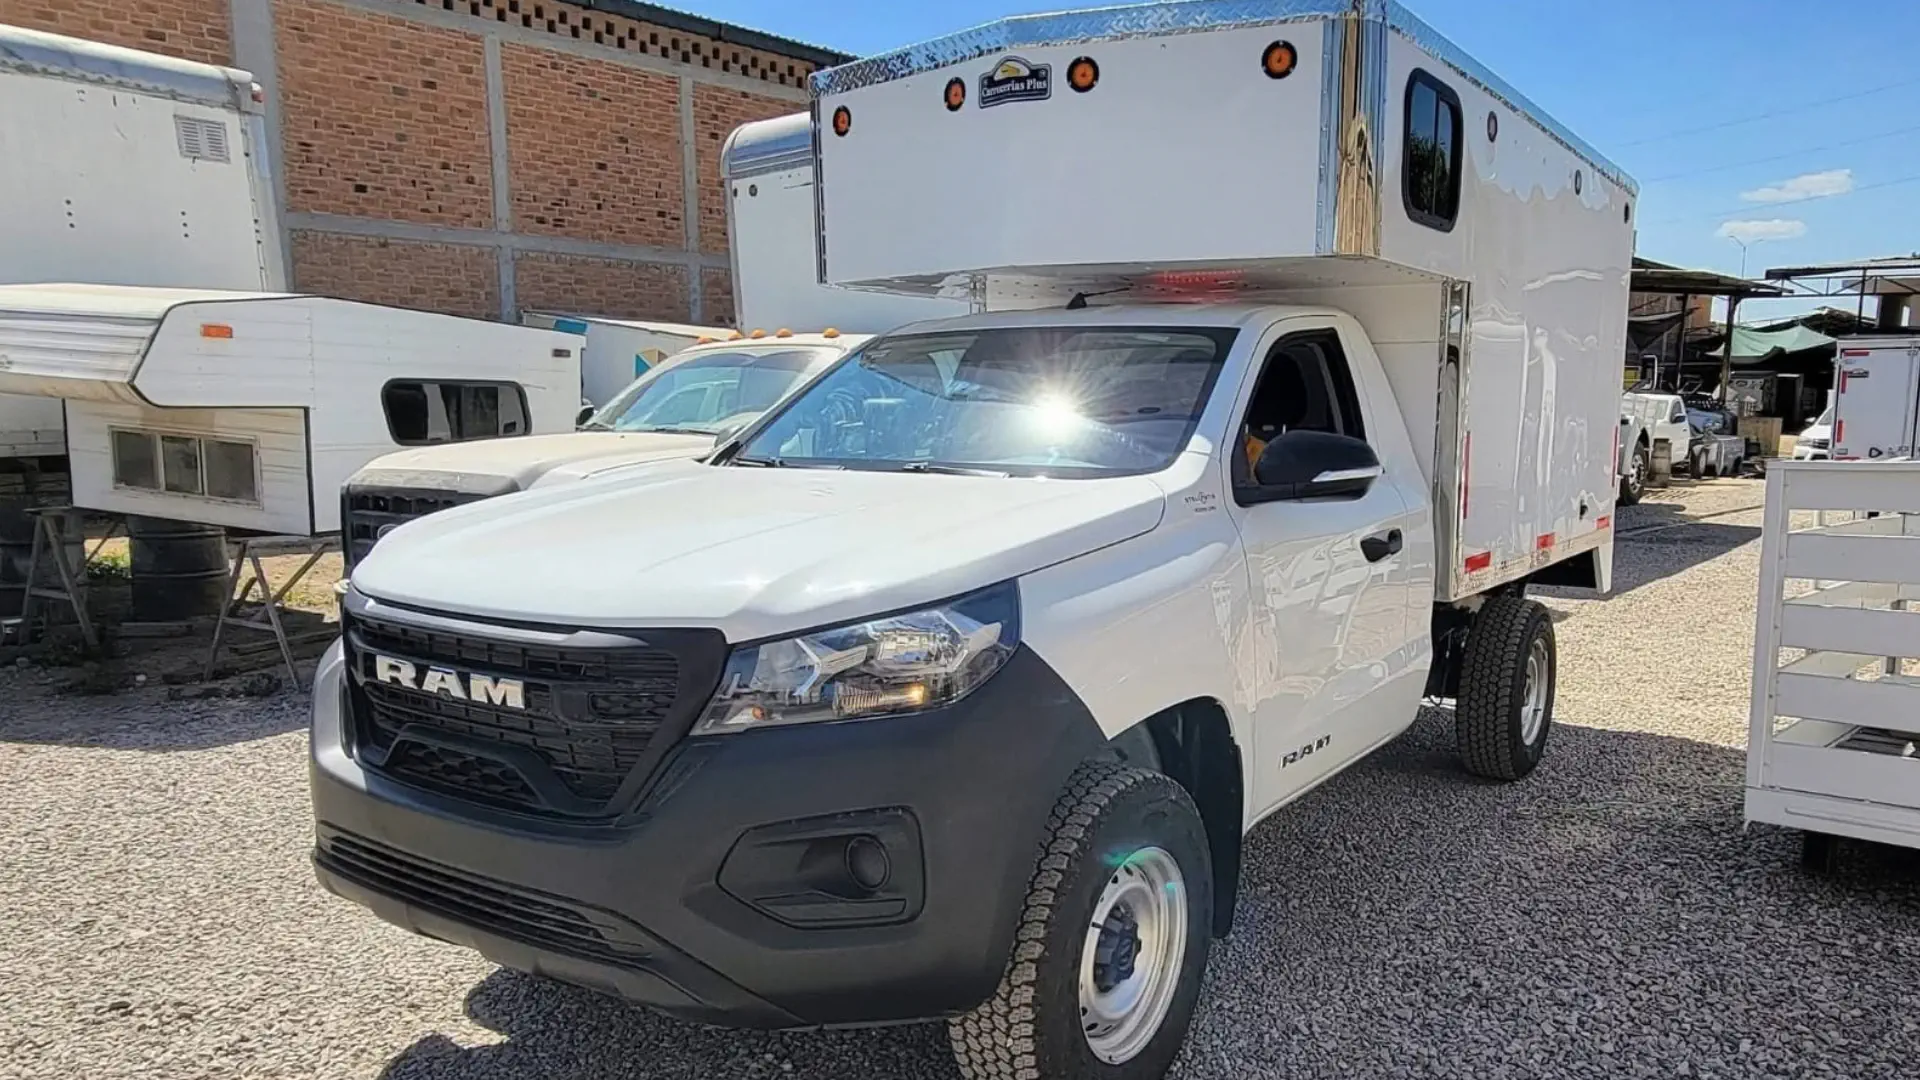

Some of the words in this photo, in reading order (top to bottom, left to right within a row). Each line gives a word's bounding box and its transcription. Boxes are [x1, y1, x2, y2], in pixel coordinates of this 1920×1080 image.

[1026, 78, 1047, 90] Plus
[376, 654, 526, 709] RAM
[1281, 734, 1331, 768] RAM
